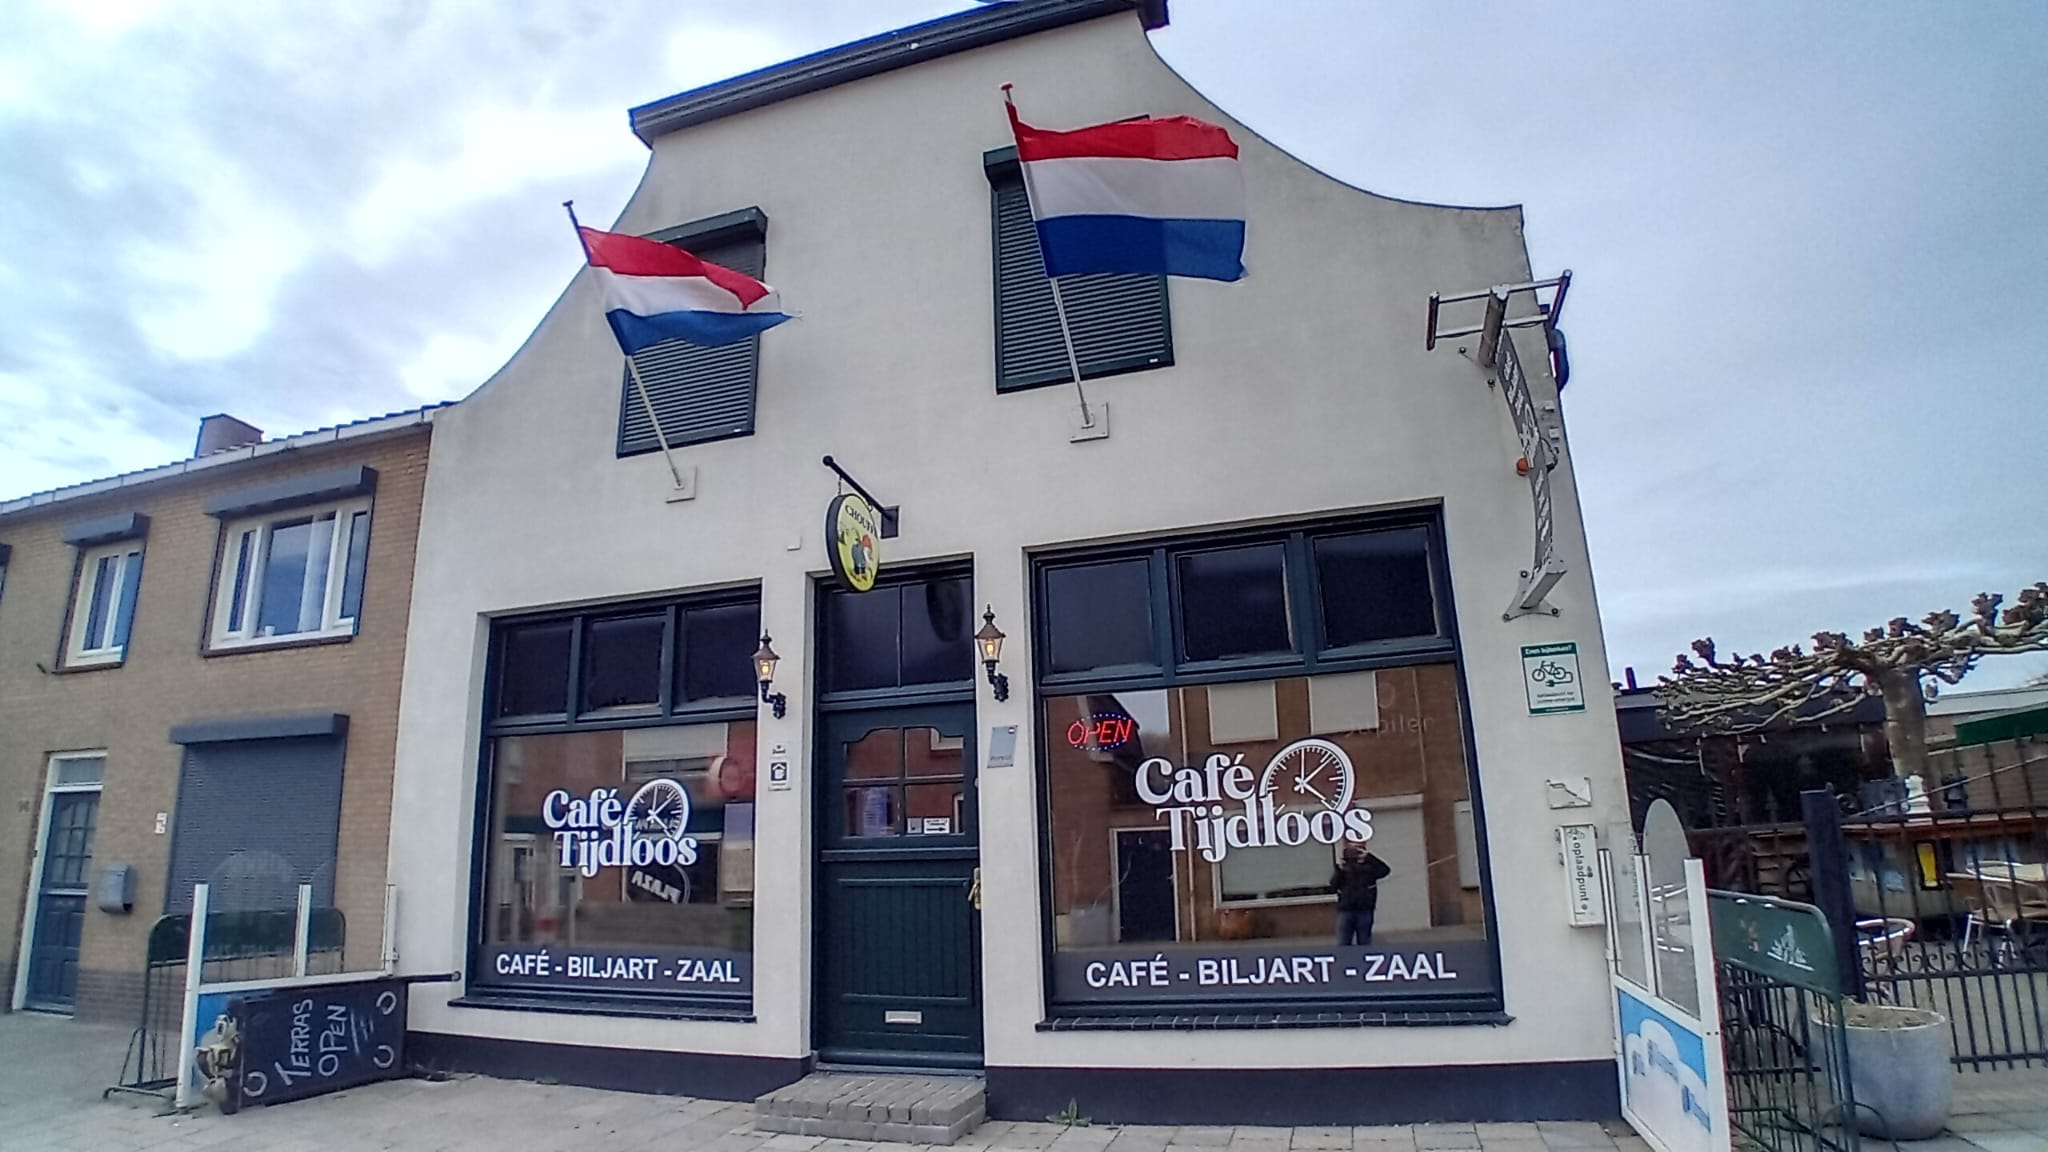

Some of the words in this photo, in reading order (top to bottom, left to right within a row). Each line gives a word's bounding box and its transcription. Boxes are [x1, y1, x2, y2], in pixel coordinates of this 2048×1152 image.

[1067, 719, 1132, 745] OPEN
[1135, 753, 1256, 805] Café
[543, 788, 622, 829] Café
[1156, 793, 1373, 863] Tijdloos
[553, 822, 698, 878] Tijdloos
[1572, 842, 1589, 901] oplaadpunt
[496, 950, 550, 976] CAFÉ
[567, 956, 658, 980] BILJART
[676, 959, 741, 983] ZAAL
[1086, 954, 1169, 988] CAFÉ
[1198, 956, 1334, 985] BILJART
[1364, 952, 1457, 982] ZAAL
[273, 998, 313, 1086] TERRAS
[318, 1004, 349, 1078] OPEN
